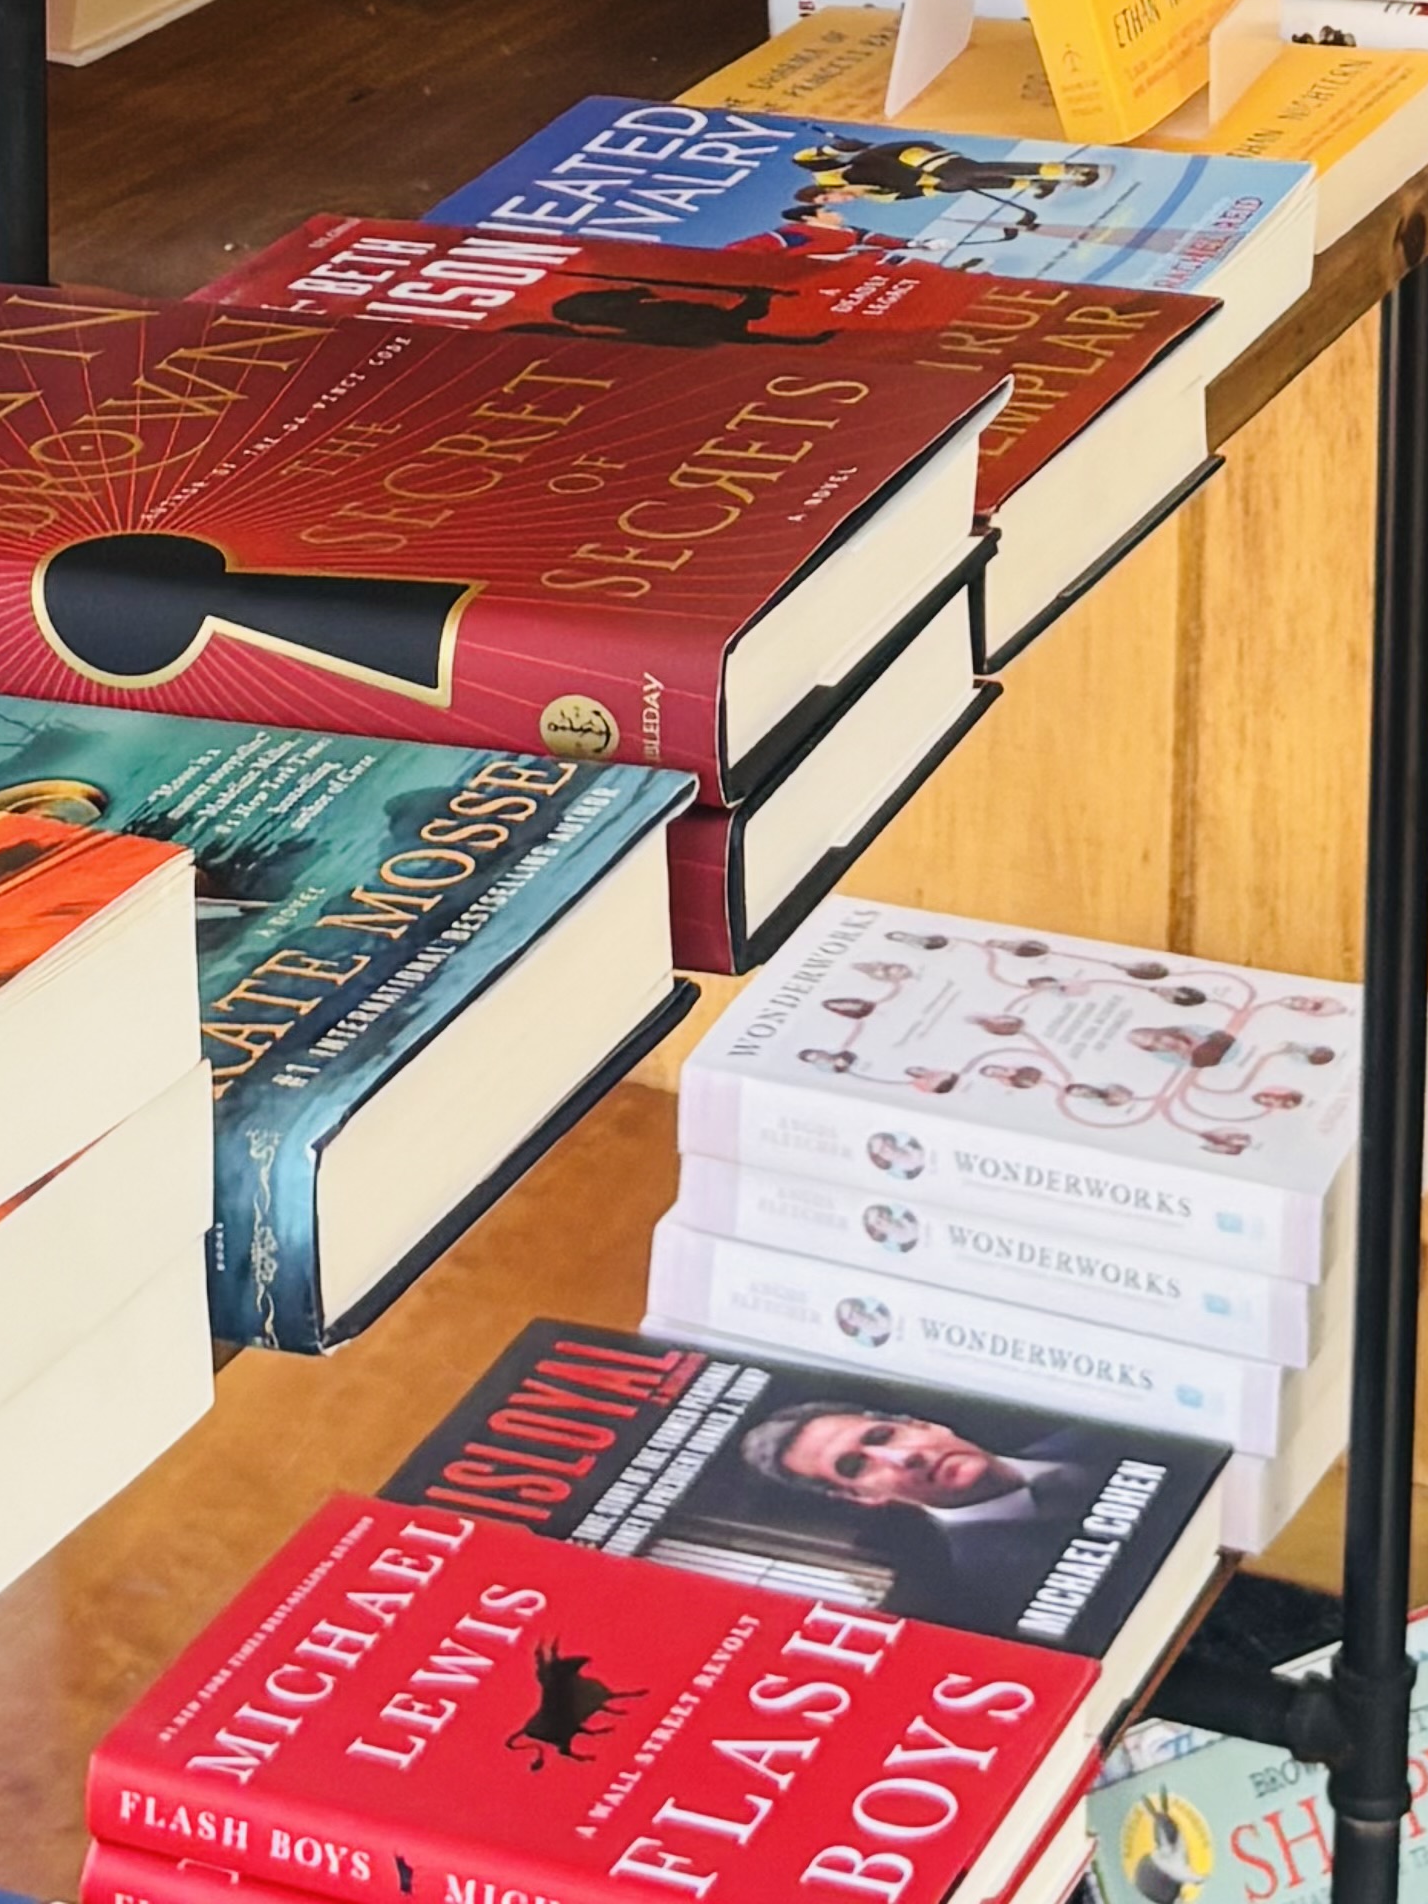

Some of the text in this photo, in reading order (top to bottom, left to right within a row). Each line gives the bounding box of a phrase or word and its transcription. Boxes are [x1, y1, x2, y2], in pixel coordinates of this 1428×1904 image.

[310, 334, 413, 414] VINCI CODE
[863, 277, 922, 316] LEGACY
[279, 420, 404, 477] THE
[301, 357, 616, 553] SECRET
[547, 452, 629, 494] OF
[803, 464, 859, 508] NOVEL
[308, 786, 622, 1059] INTERNATIONAL BESTSELLING AUTHOR
[318, 759, 579, 941] MOSSE
[727, 905, 882, 1061] WONDERWORKS
[953, 1148, 1194, 1220] WONDERWORKS
[946, 1224, 1184, 1301] WONDERWORKS
[919, 1316, 1155, 1392] WONDERWORKS
[1018, 1457, 1169, 1639] MICHAEL COHEN
[186, 1517, 476, 1784] MICHAEL
[346, 1583, 548, 1771] LEWIS
[575, 1611, 761, 1840] A WALL STREET REVOLT
[612, 1600, 912, 1901] FLASH
[800, 1669, 1037, 1904] BOYS
[117, 1790, 373, 1884] FLASH BOYS
